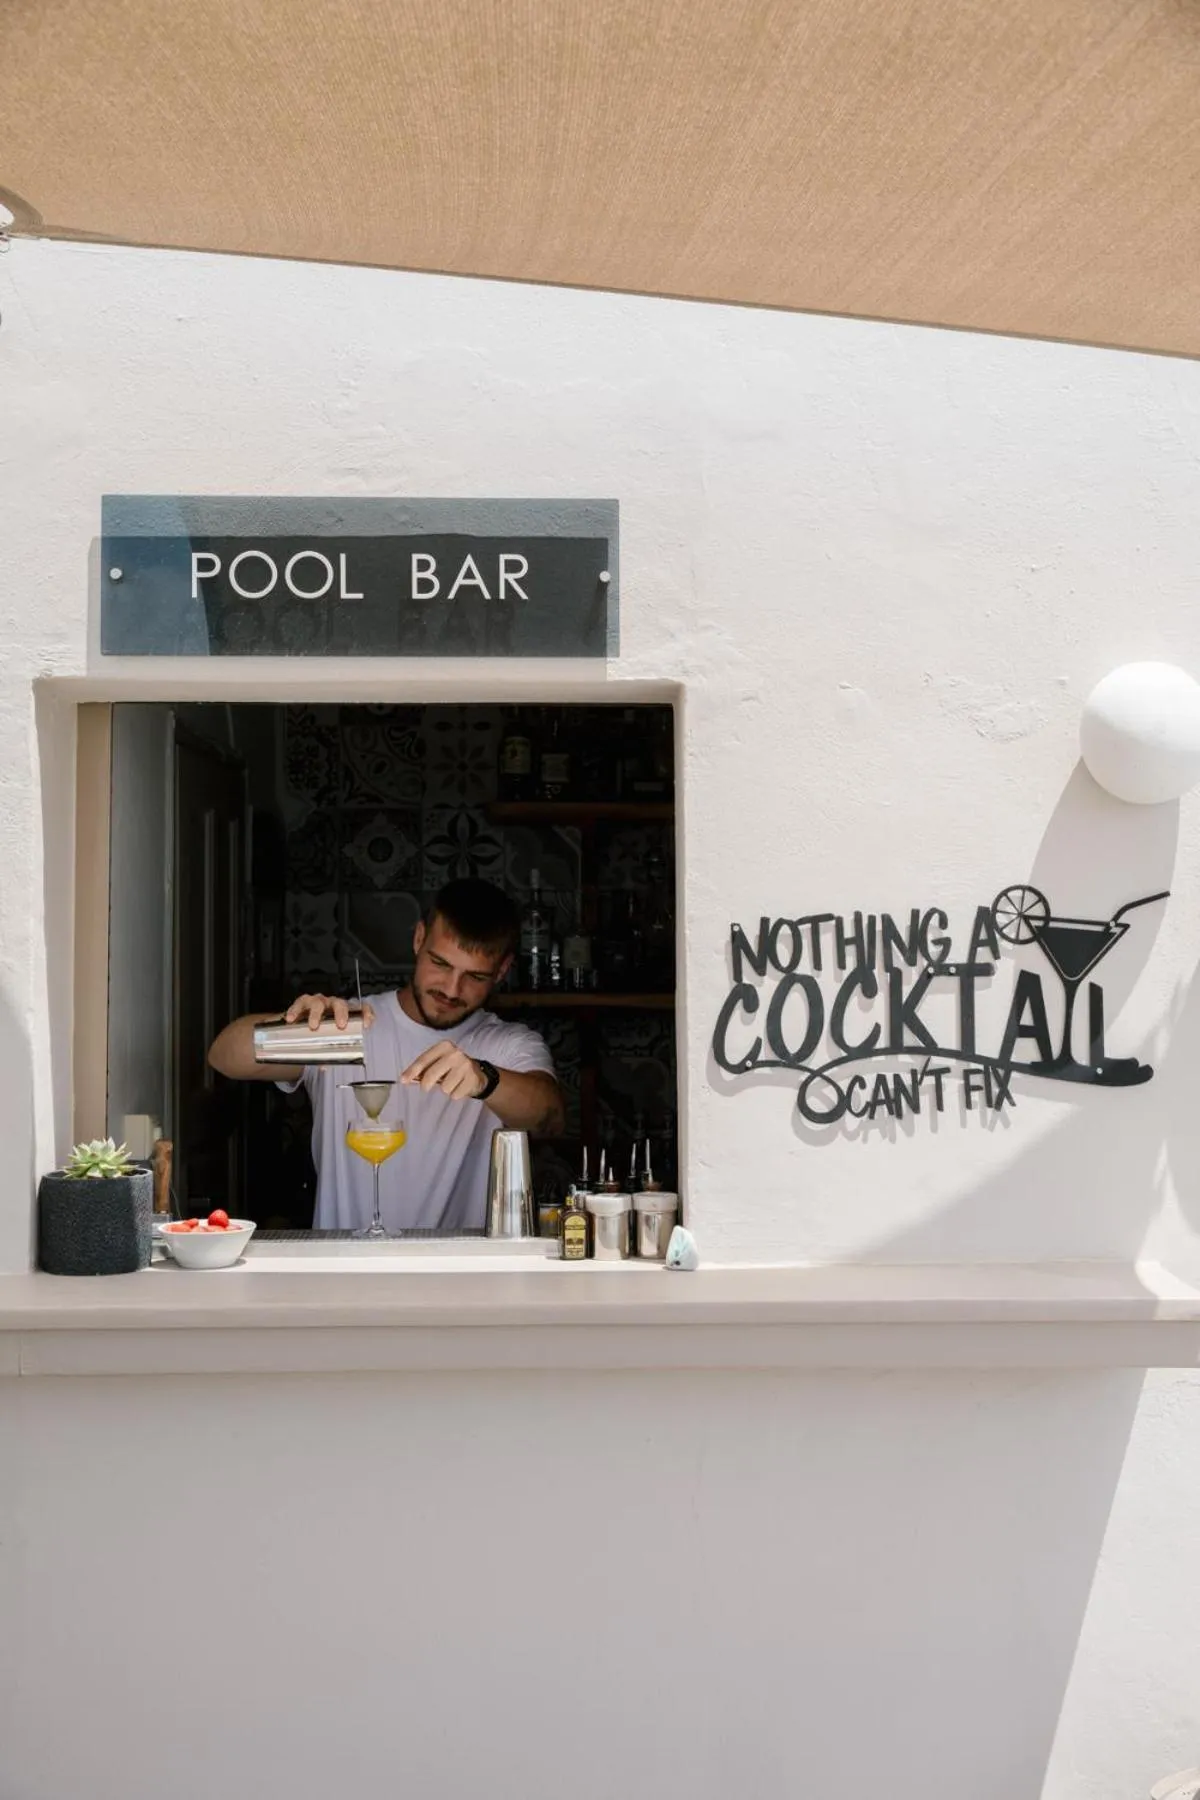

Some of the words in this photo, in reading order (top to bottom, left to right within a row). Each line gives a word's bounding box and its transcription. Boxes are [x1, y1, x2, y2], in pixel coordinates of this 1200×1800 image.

[191, 550, 364, 599] POOL
[411, 553, 529, 599] BAR
[731, 908, 950, 983] NOTHING
[968, 906, 1000, 966] A
[712, 968, 1154, 1086] COCKTAIL
[847, 1056, 951, 1119] CAN'T
[963, 1064, 1016, 1112] FIX
